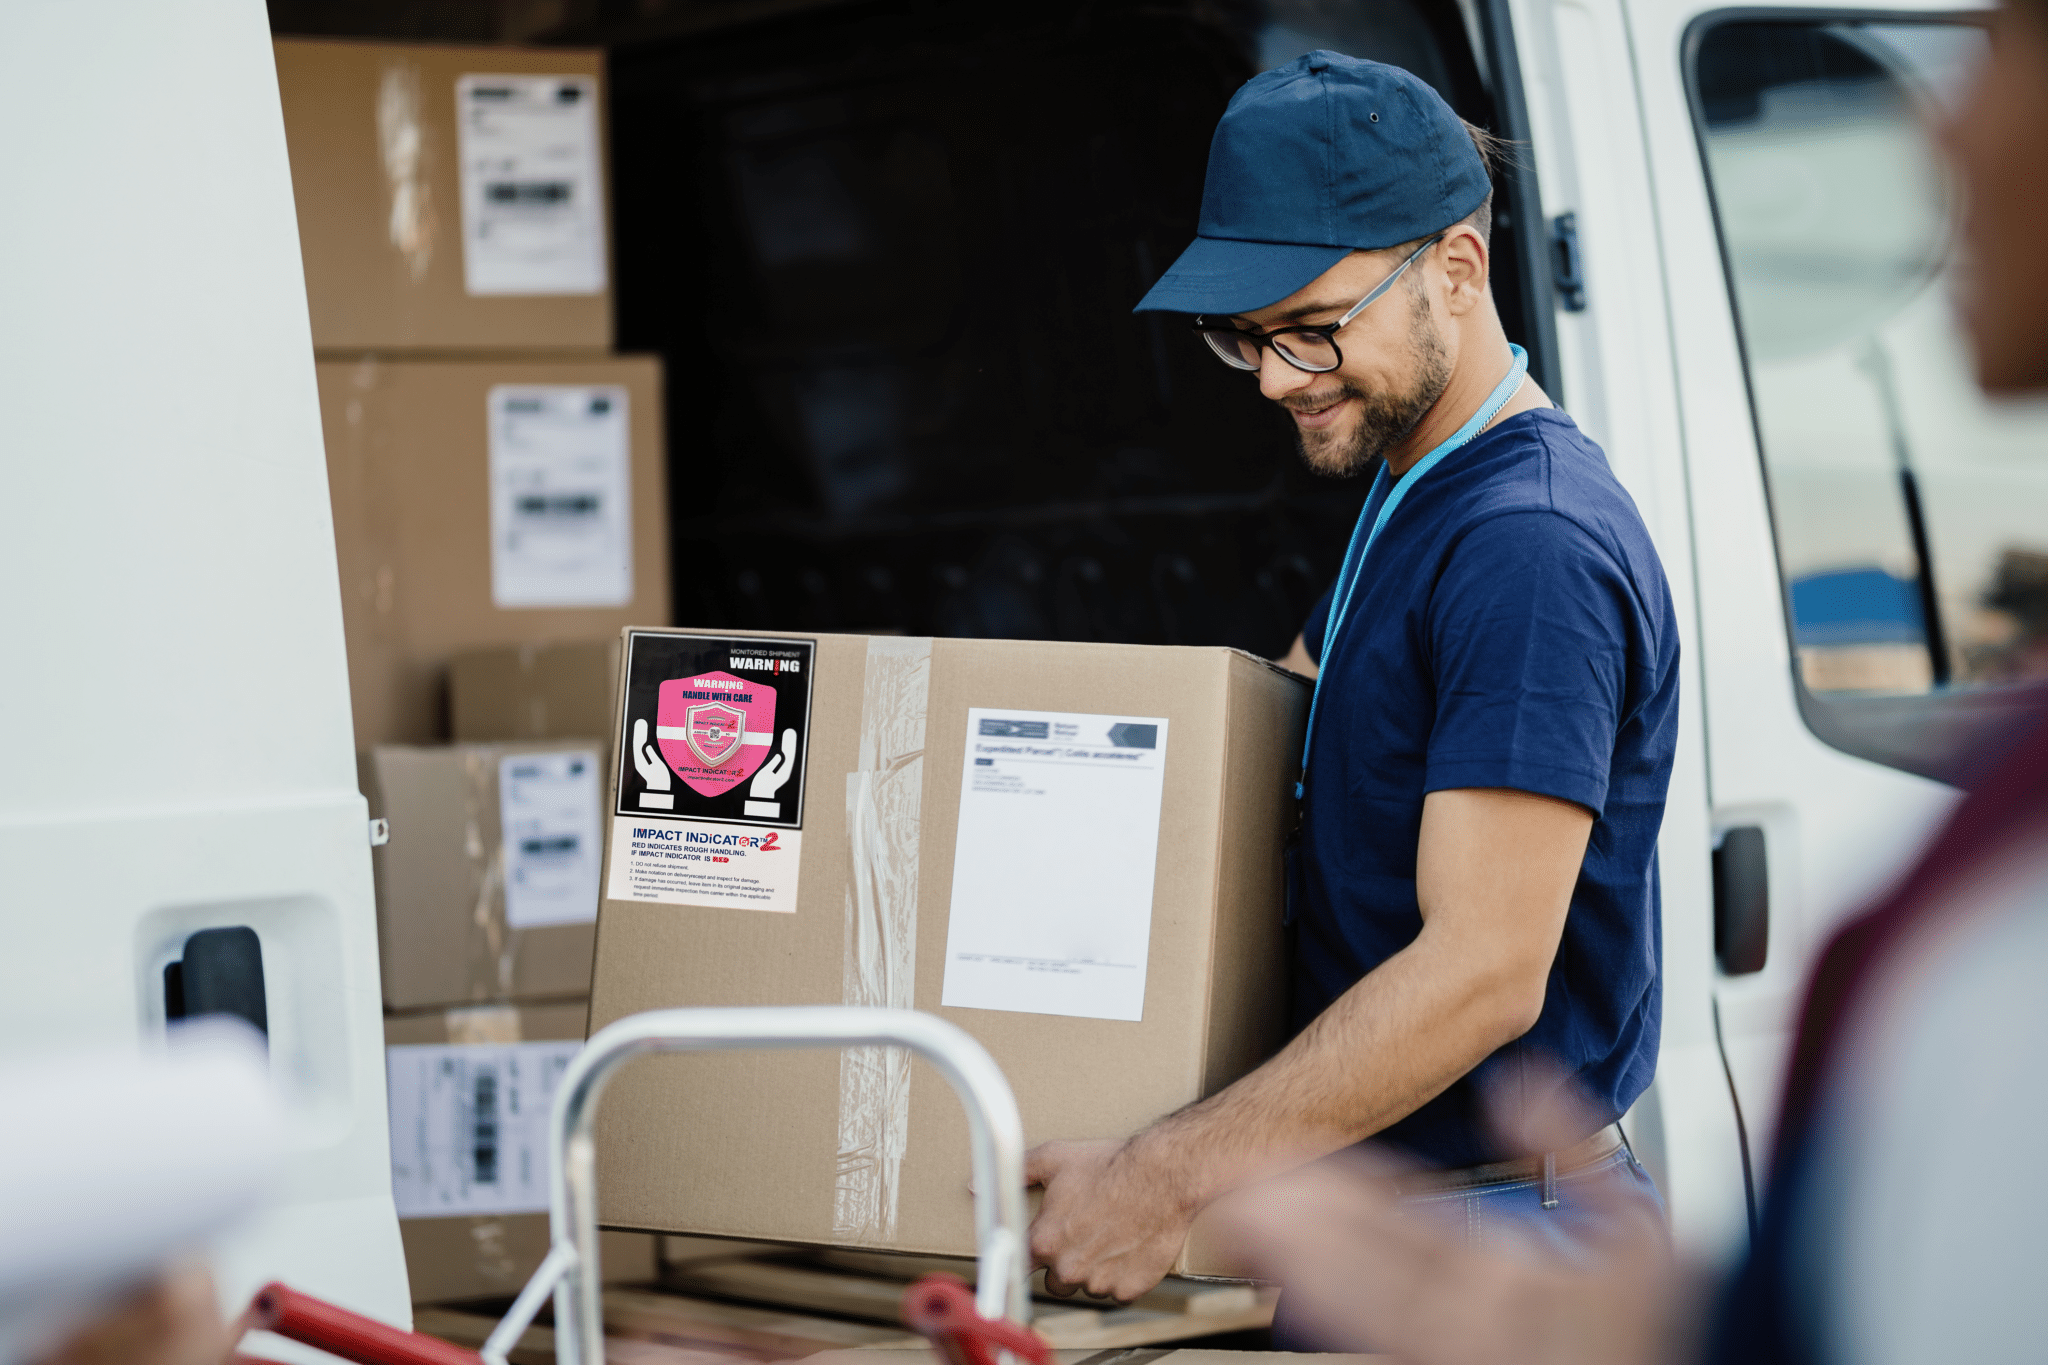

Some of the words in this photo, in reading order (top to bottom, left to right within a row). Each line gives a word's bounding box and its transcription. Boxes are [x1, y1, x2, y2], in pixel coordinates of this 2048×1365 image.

[730, 648, 768, 656] MONITORED
[769, 650, 800, 658] SHIPMENT
[682, 690, 710, 700] HANDLE
[711, 692, 732, 702] WITH
[733, 693, 753, 703] CARE
[632, 827, 683, 841] IMPACT
[631, 841, 646, 849] RED
[647, 843, 683, 852] INDICATES
[683, 845, 709, 854] ROUGH
[709, 847, 747, 857] HANDLING.
[638, 850, 664, 858] IMPACT
[664, 852, 701, 861] INDICATOR
